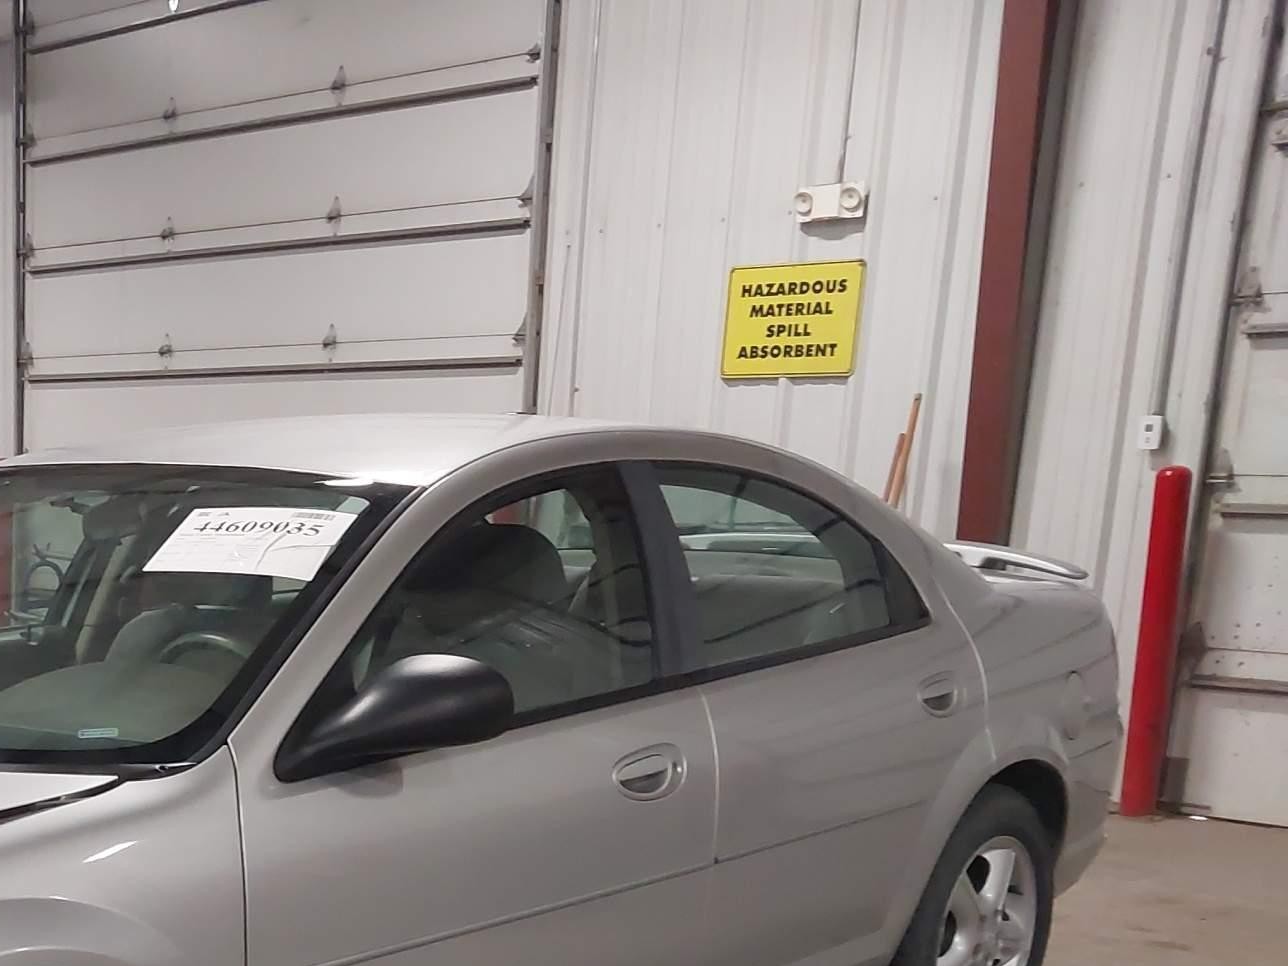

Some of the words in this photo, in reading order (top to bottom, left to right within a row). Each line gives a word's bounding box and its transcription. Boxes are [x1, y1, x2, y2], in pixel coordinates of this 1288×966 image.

[740, 279, 848, 298] HAZARDOUS
[749, 301, 833, 318] MATERIAL
[765, 323, 812, 338] SPILL
[736, 343, 838, 359] ABSORBENT
[193, 520, 324, 536] 44609035
